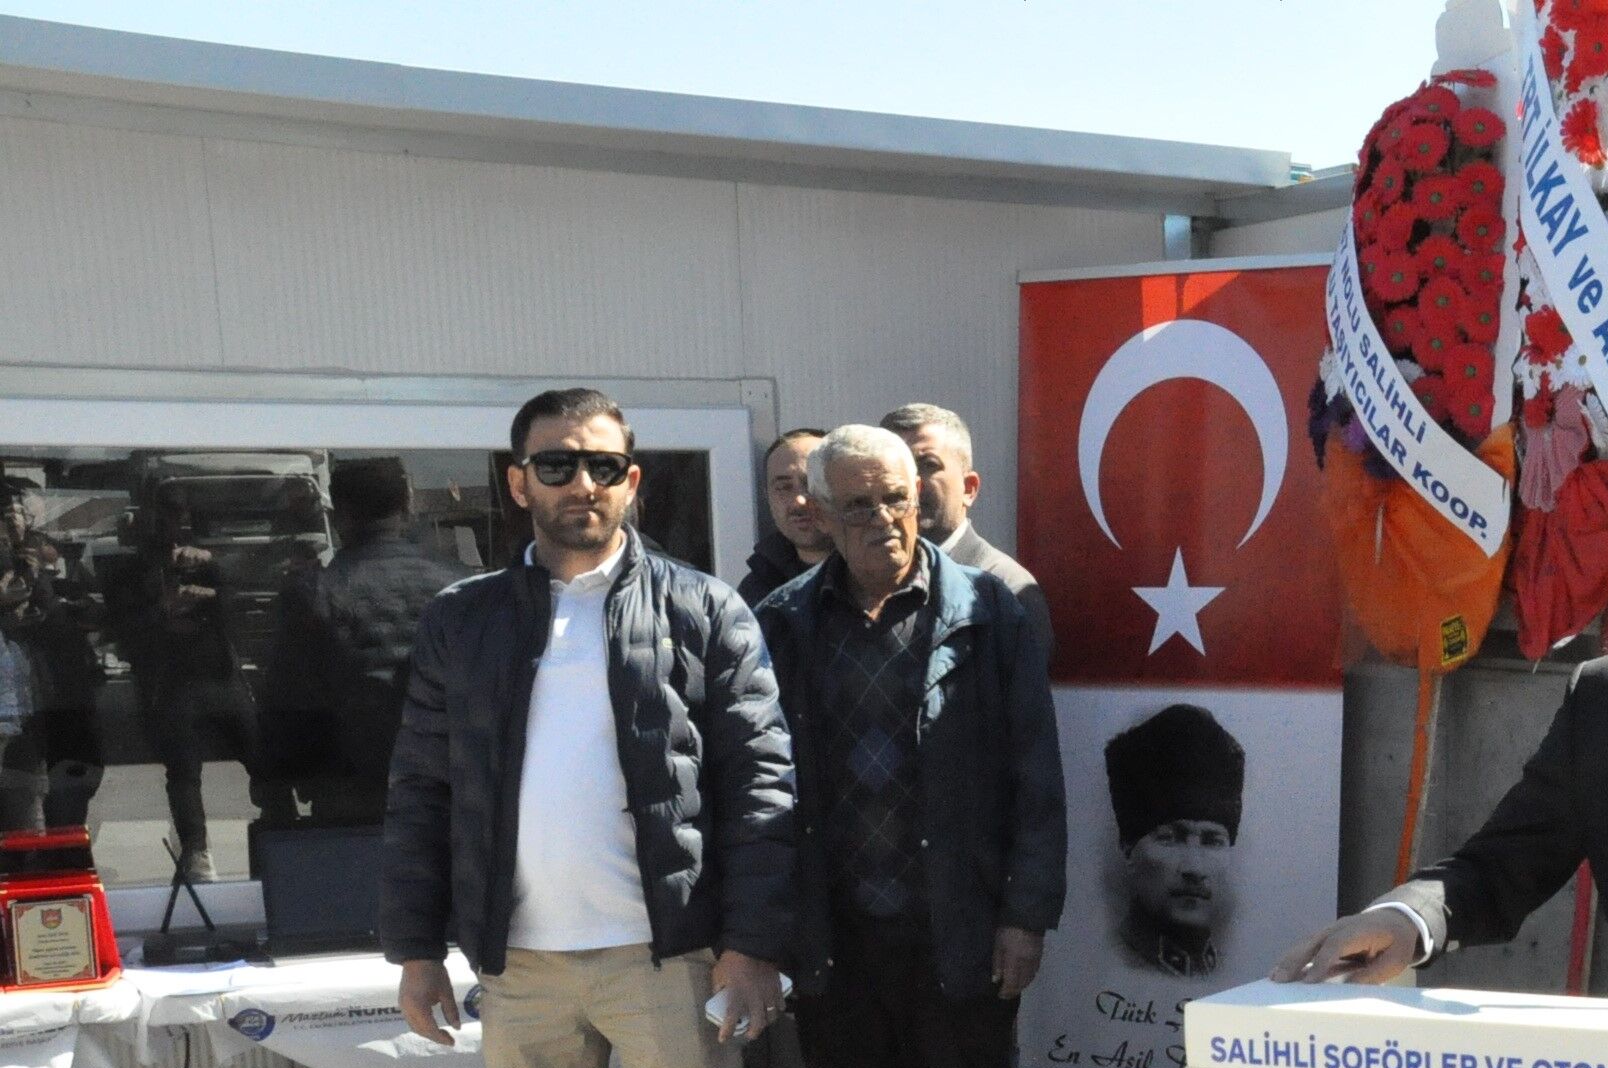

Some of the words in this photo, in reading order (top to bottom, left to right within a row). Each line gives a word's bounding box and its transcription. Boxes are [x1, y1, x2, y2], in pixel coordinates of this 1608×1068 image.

[1524, 117, 1589, 257] İLKAY
[1567, 255, 1604, 315] ve
[1330, 295, 1406, 467] TAŞIYICILAR
[1412, 460, 1488, 539] KOOP.
[1359, 333, 1427, 444] SALİHLİ
[1096, 991, 1158, 1024] Türk
[1048, 1034, 1081, 1065] En
[1210, 1031, 1317, 1068] SALİHLİ
